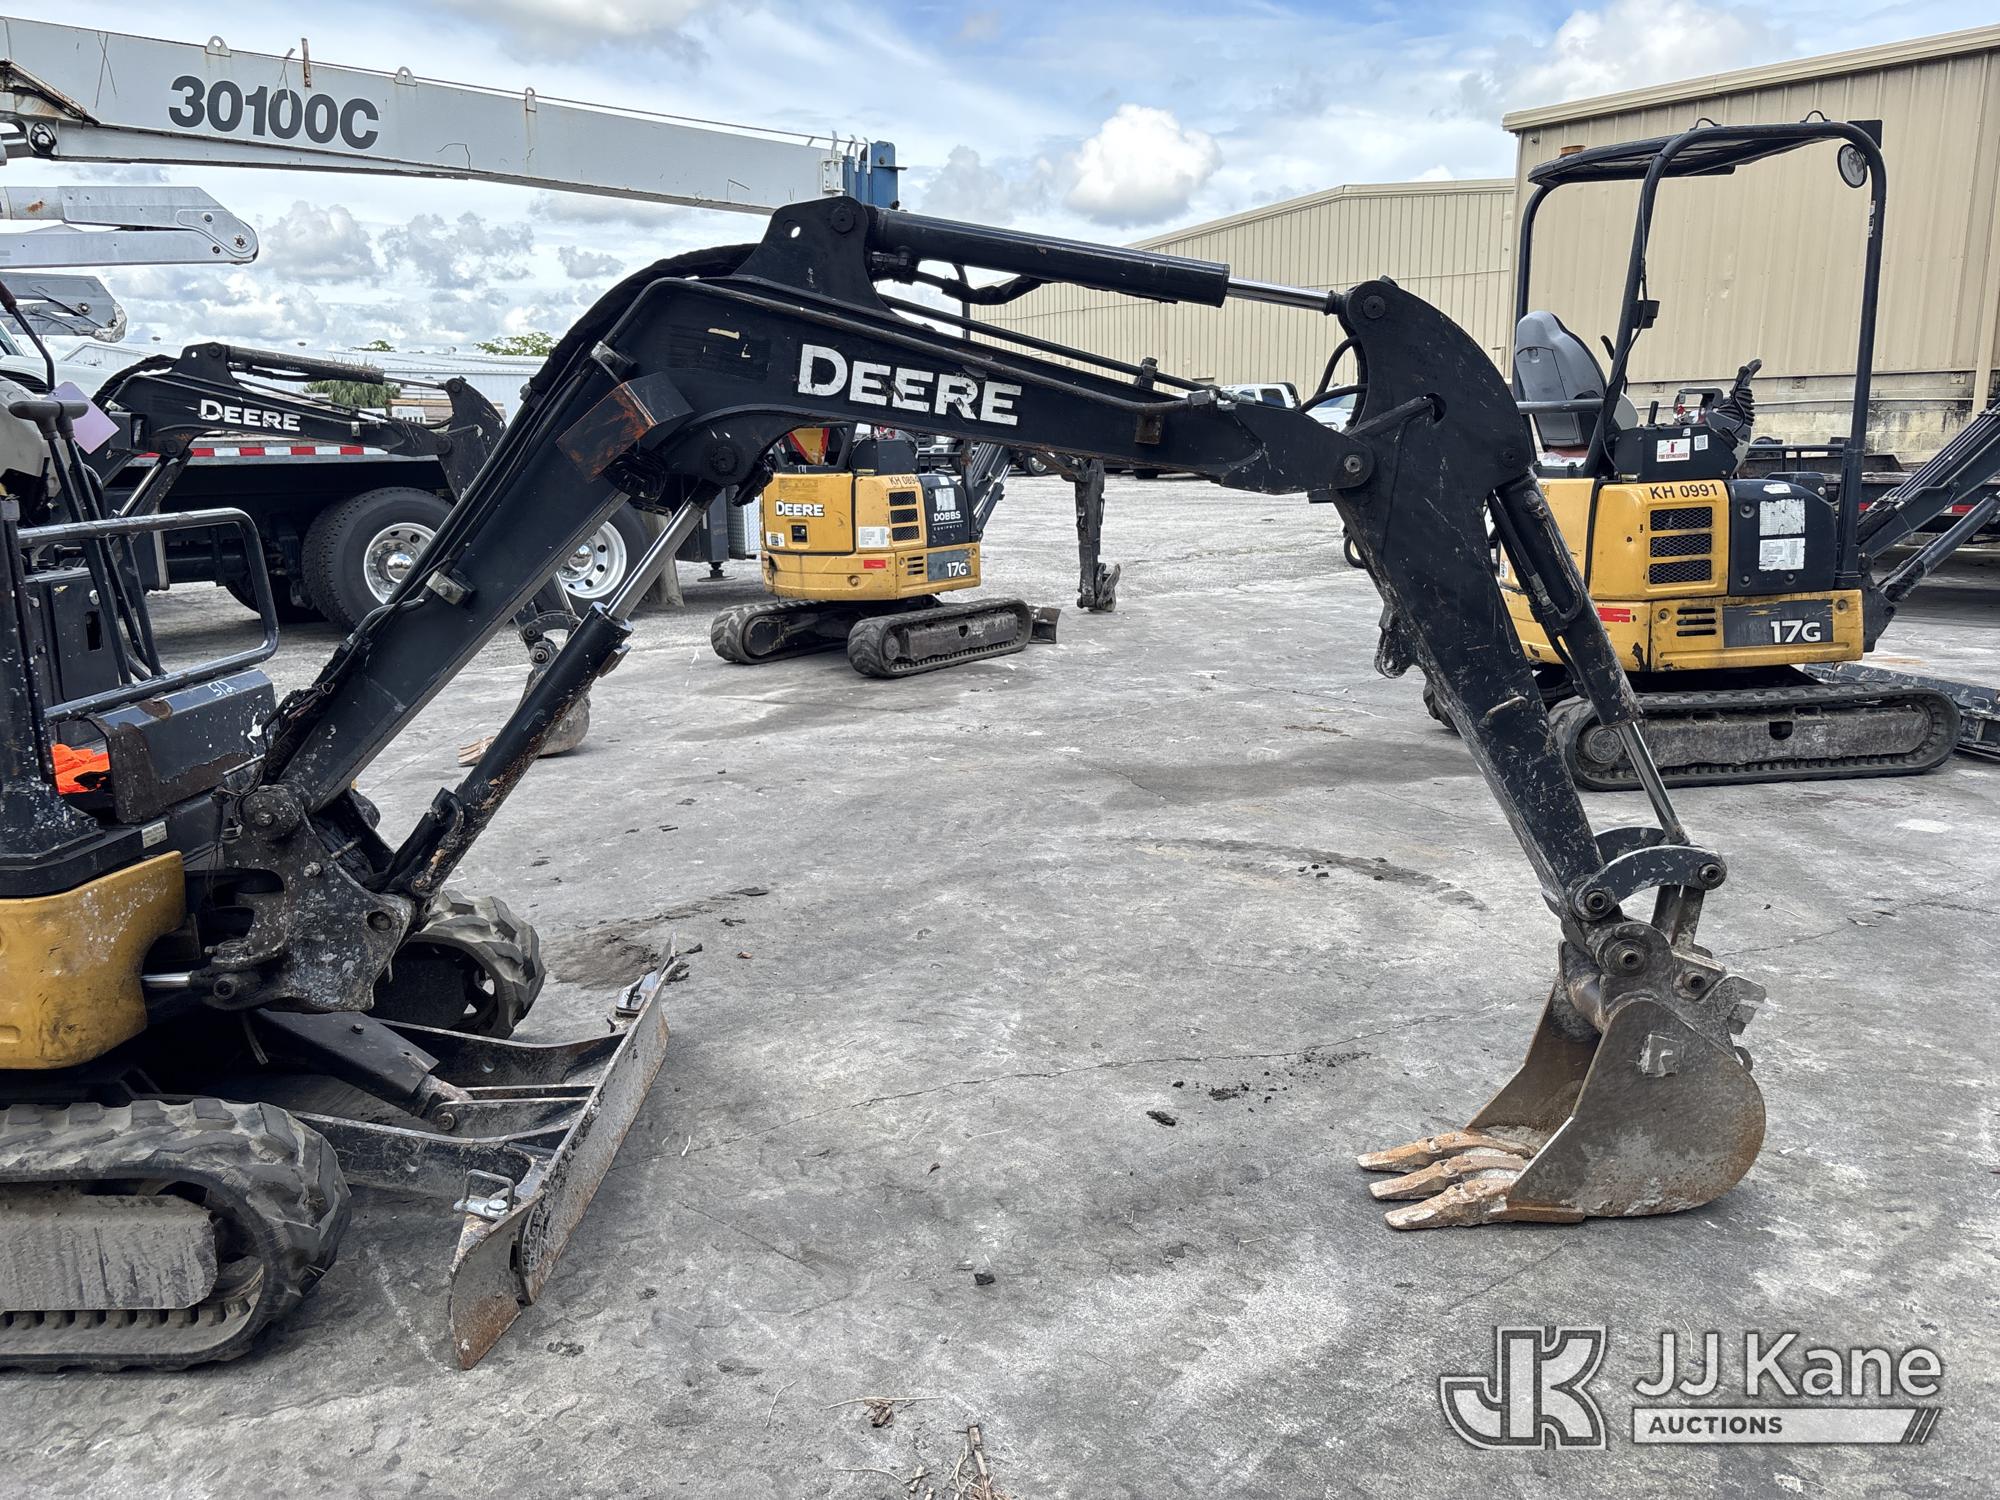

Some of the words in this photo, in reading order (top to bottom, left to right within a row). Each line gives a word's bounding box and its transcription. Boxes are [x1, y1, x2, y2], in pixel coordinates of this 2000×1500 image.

[169, 75, 379, 149] 30100C
[798, 344, 1022, 425] DEERE
[198, 399, 301, 431] DEERE
[1649, 485, 1675, 499] KH
[1680, 483, 1718, 498] 0991
[775, 500, 825, 517] DEERE
[933, 510, 961, 521] DOBBS
[946, 562, 967, 577] 17G
[1771, 620, 1821, 643] 17G
